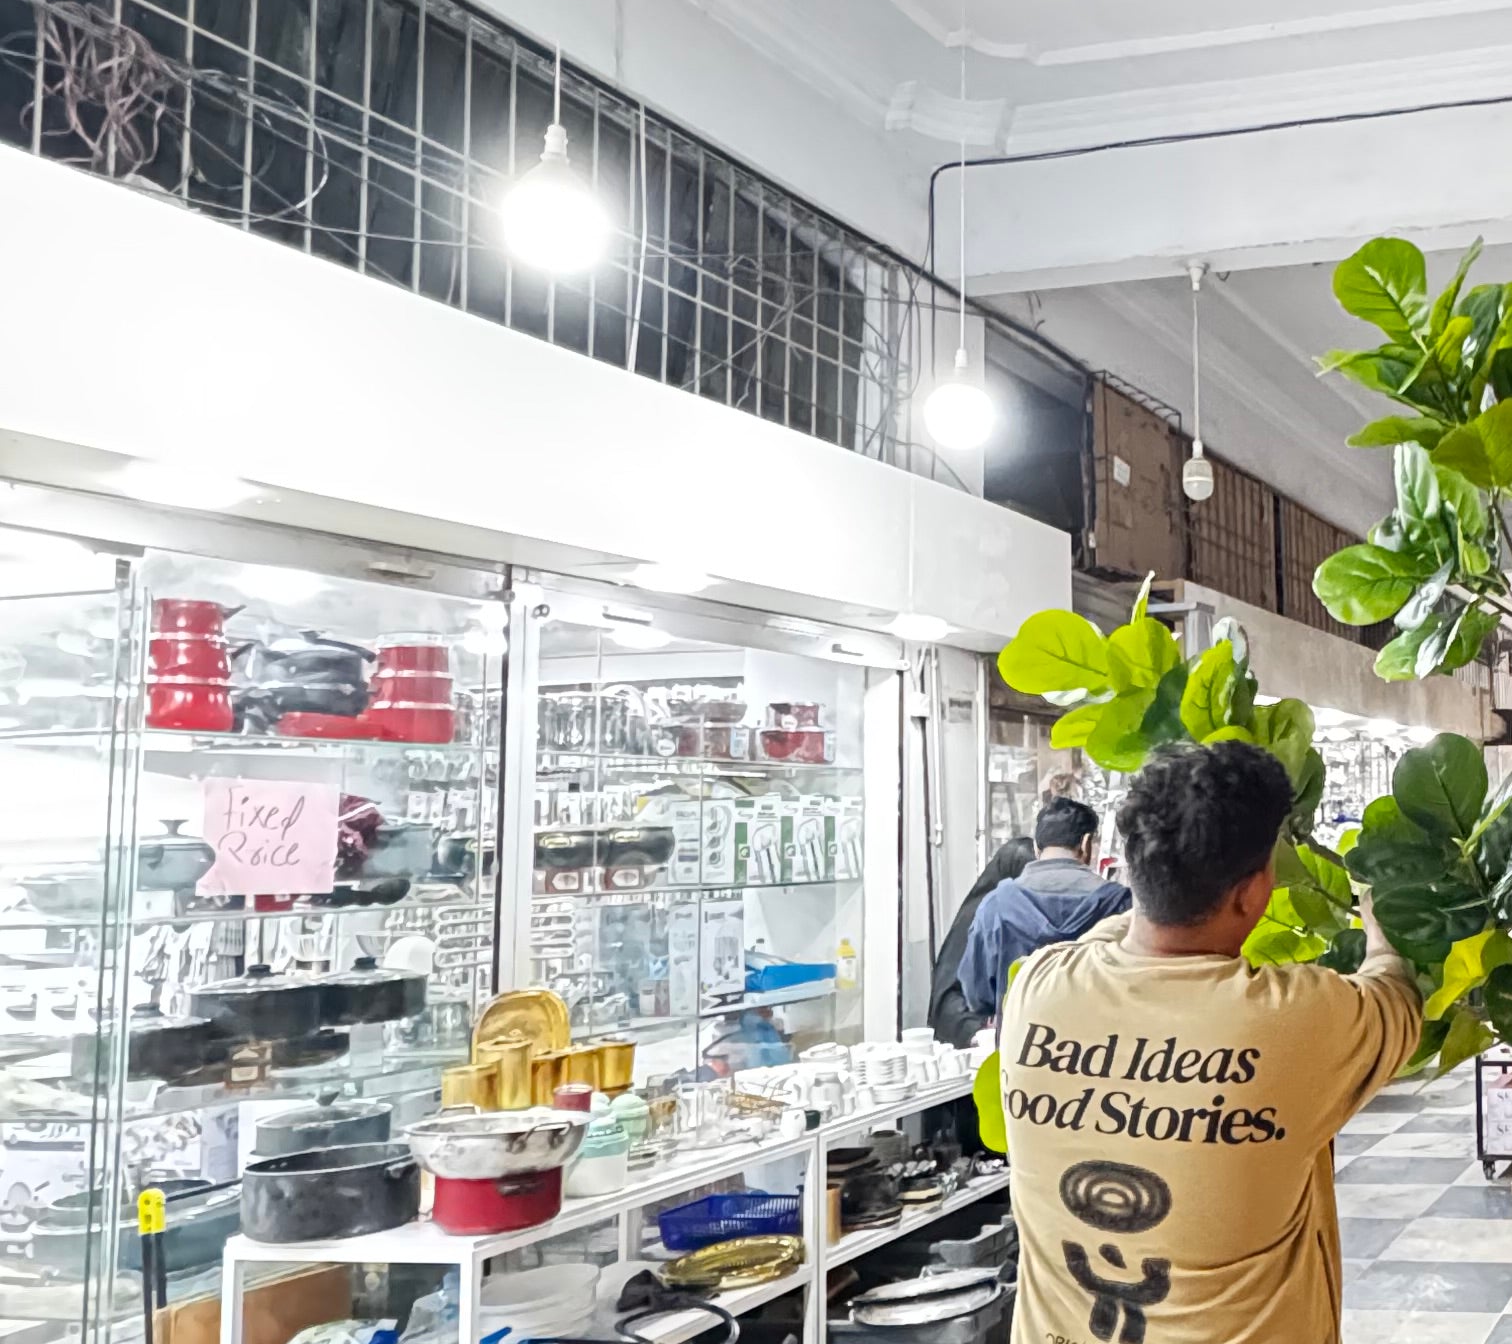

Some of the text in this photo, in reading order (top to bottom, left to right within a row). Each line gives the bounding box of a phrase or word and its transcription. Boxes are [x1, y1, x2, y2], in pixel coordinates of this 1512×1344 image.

[1016, 1023, 1261, 1084] Bad Ideas
[1095, 1091, 1286, 1145] Stories.
